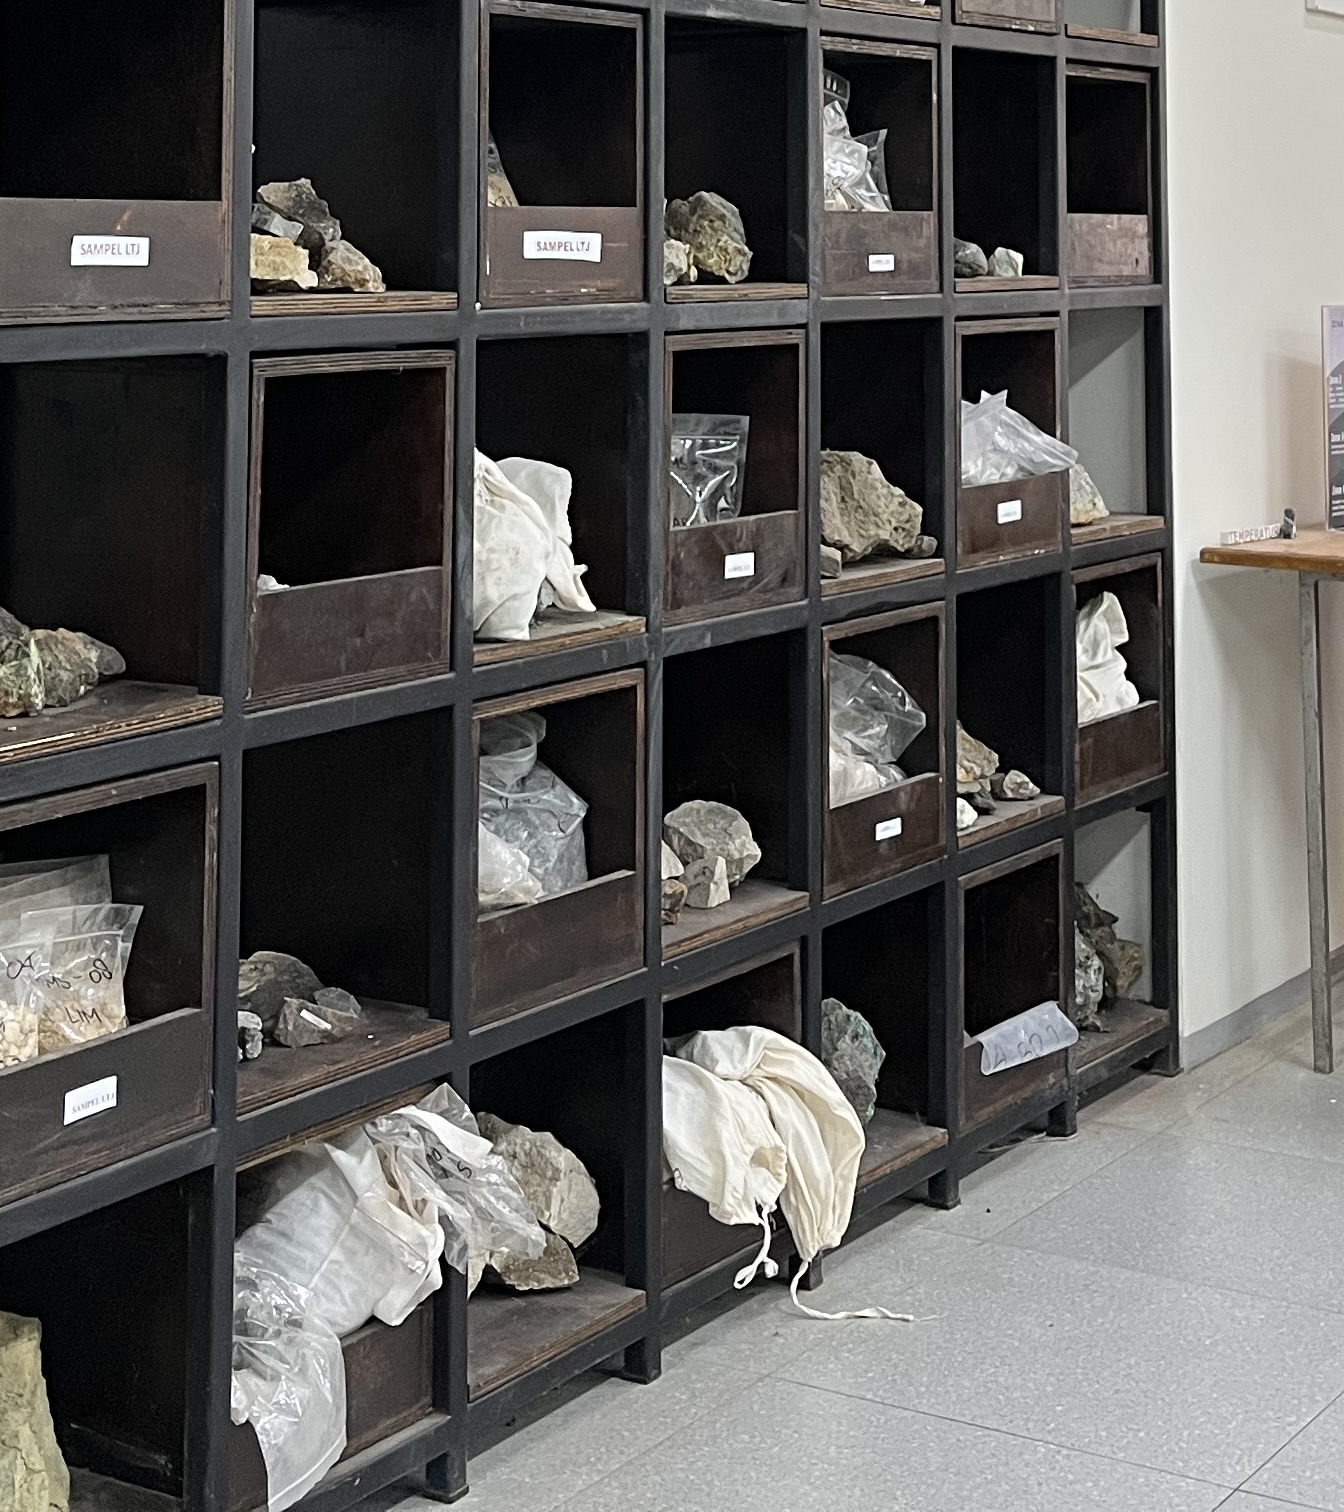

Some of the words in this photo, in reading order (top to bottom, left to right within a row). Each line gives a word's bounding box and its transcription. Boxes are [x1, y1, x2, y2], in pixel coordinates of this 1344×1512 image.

[80, 243, 123, 256] SAMPEL
[125, 243, 141, 256] LTJ
[536, 240, 575, 252] SAMPEL
[576, 241, 591, 252] LTJ
[65, 1006, 103, 1024] LIM
[71, 1097, 101, 1115] SAMPEL
